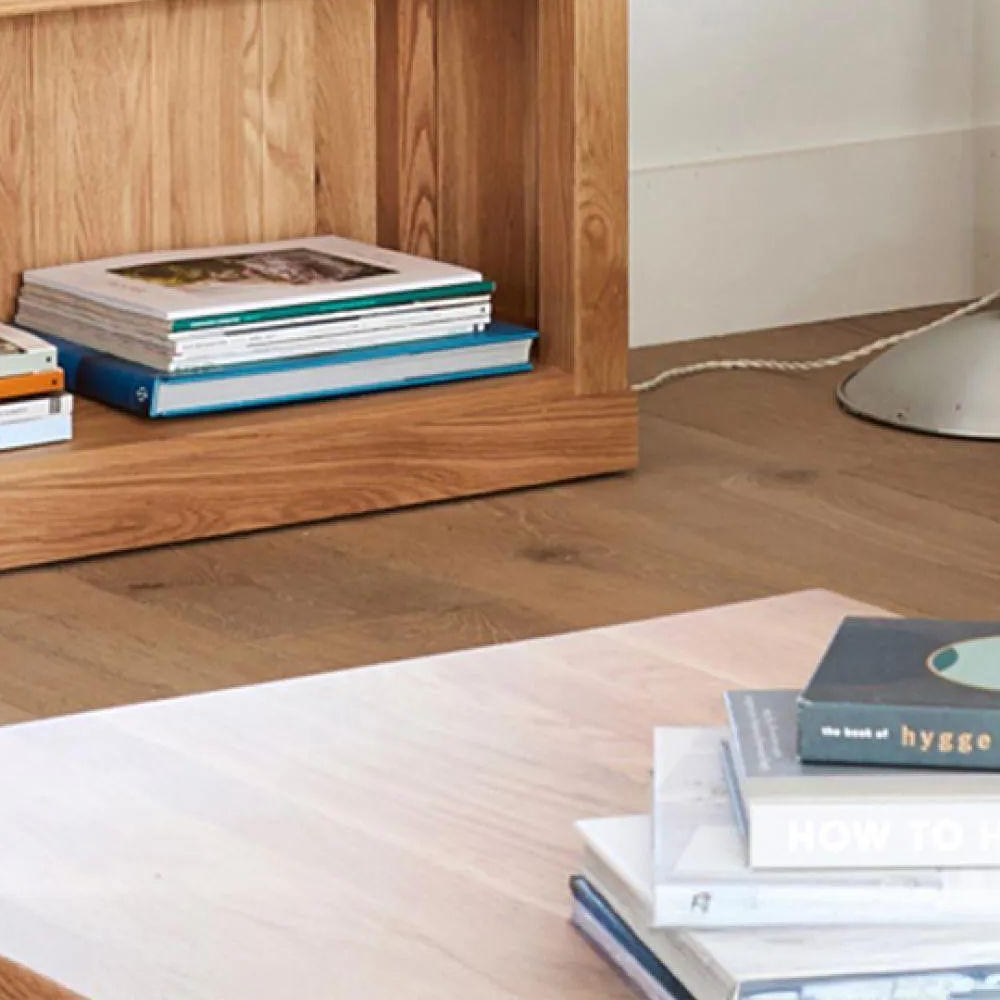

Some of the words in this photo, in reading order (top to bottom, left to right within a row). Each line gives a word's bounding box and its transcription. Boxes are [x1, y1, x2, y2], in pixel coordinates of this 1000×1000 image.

[821, 726, 840, 737] the
[844, 726, 872, 738] book
[875, 727, 889, 739] of
[900, 724, 992, 754] hygge
[788, 819, 890, 853] HOW
[909, 818, 964, 852] TO
